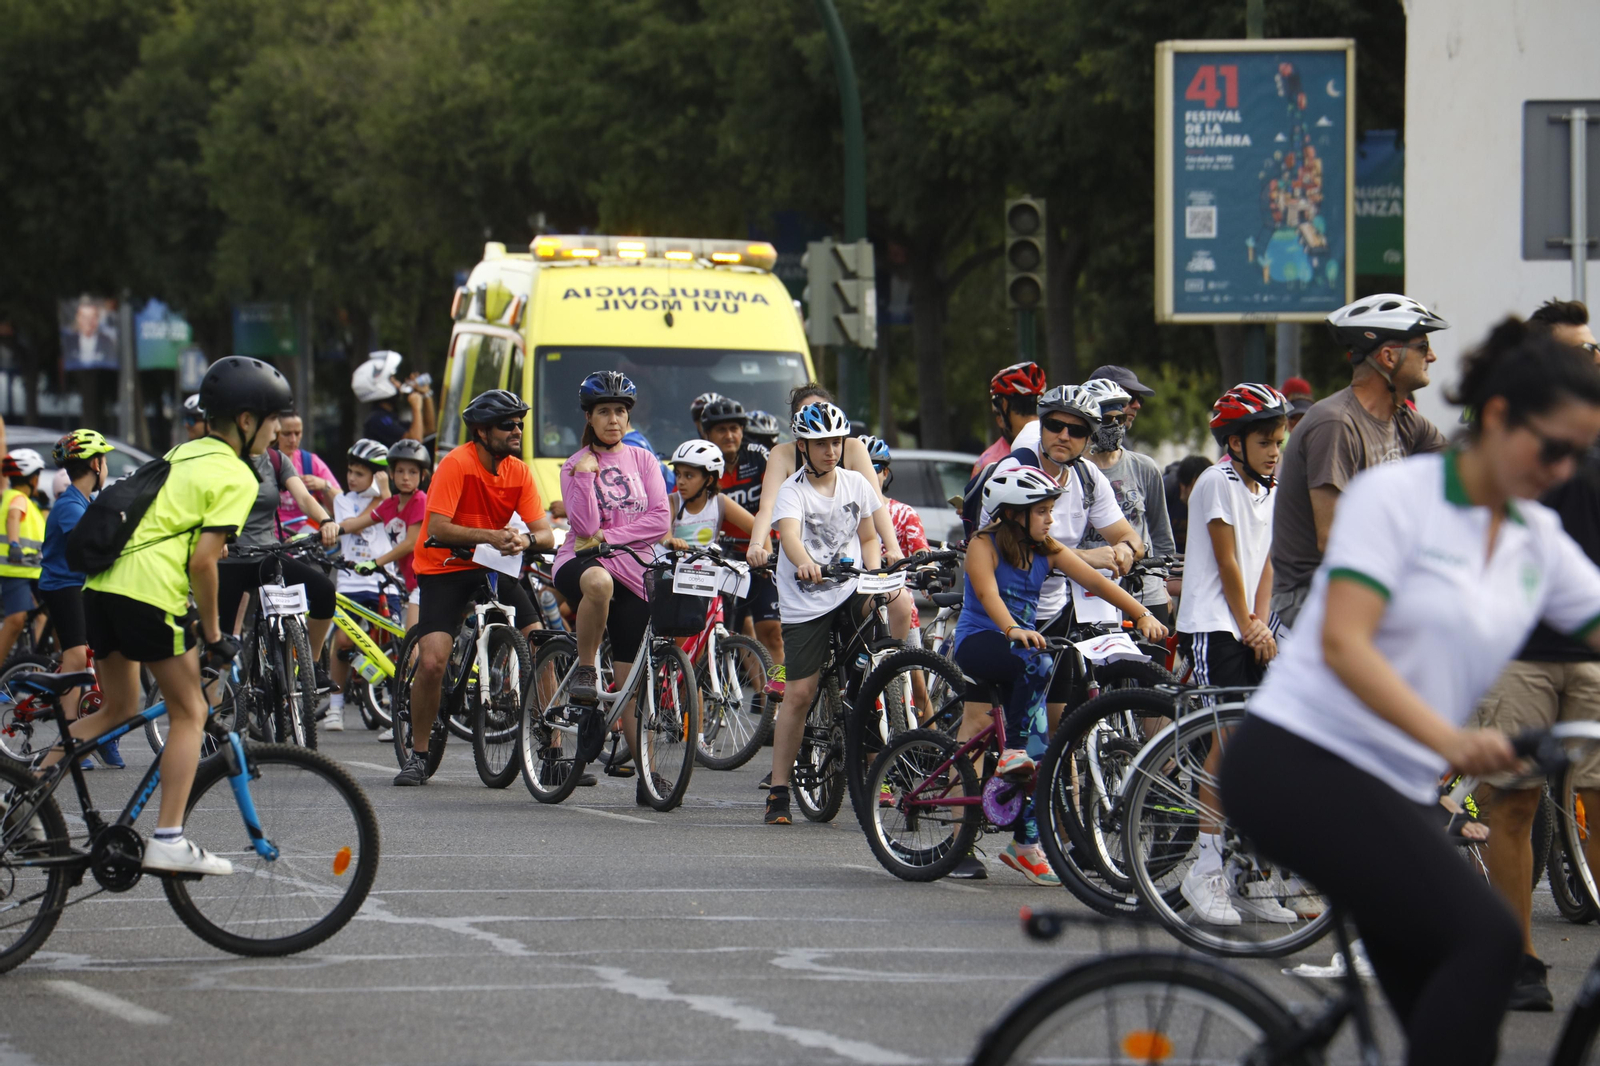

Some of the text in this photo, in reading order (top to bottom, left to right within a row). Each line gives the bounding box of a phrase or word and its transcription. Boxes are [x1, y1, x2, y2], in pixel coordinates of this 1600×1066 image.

[1185, 66, 1238, 108] 41
[1185, 111, 1241, 122] FESTIVAL
[1185, 123, 1222, 135] DE LA
[1185, 135, 1251, 147] GUITARRA
